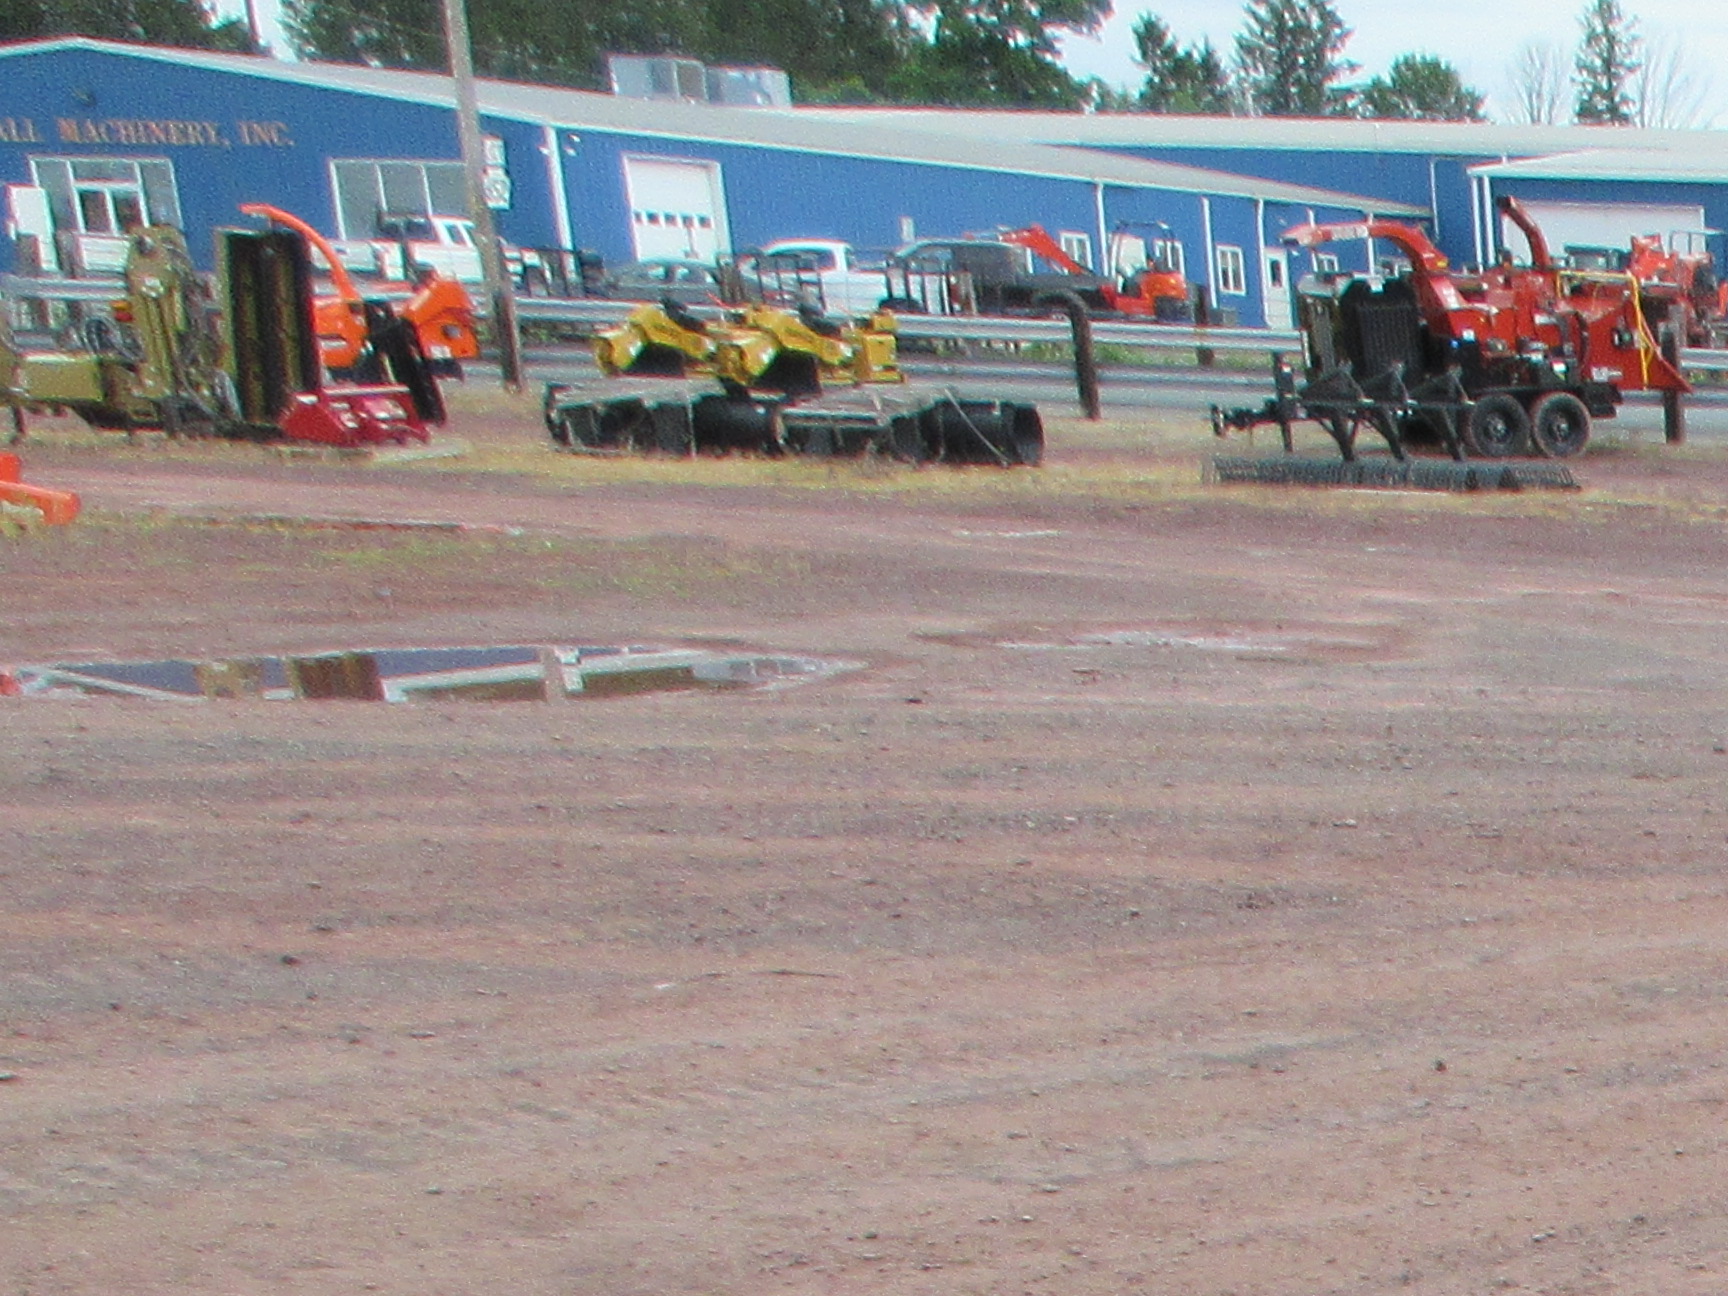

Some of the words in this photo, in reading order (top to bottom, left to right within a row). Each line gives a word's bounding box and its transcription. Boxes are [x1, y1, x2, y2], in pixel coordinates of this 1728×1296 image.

[0, 117, 43, 143] LL
[55, 117, 231, 147] MACHINERY,
[236, 119, 294, 147] INC.
